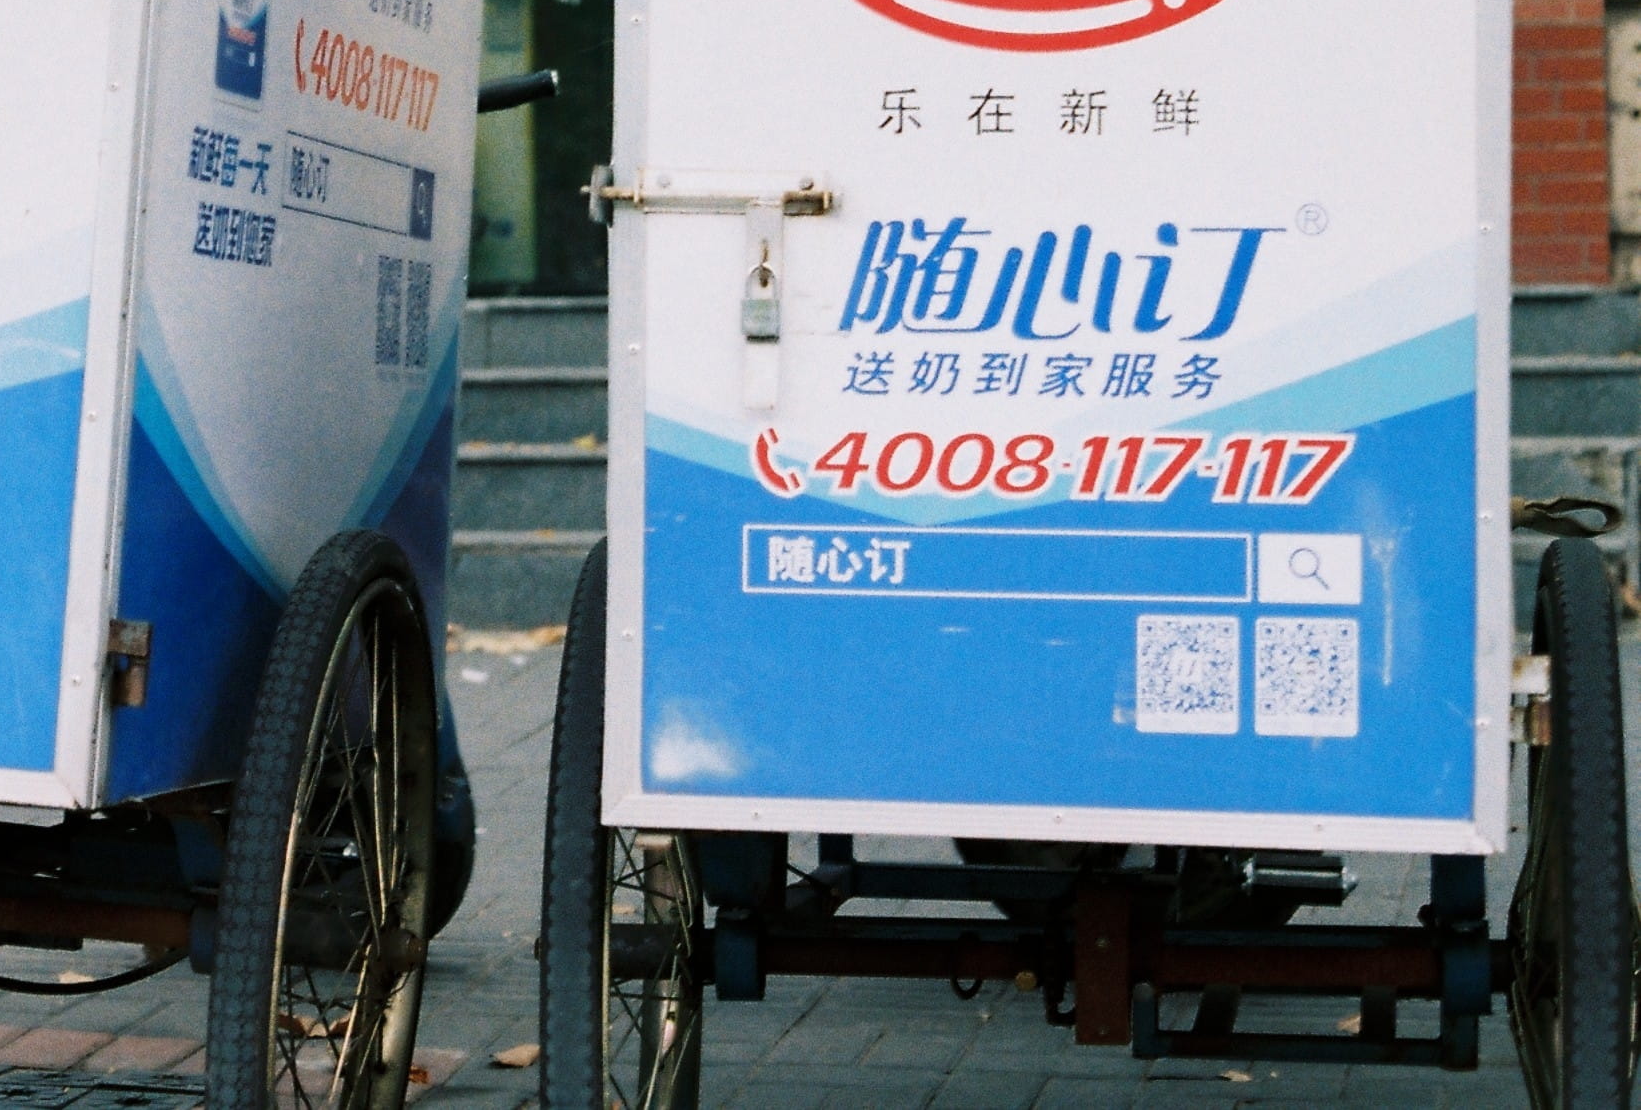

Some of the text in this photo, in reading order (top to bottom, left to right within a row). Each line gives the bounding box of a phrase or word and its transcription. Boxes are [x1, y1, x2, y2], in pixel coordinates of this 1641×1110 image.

[878, 89, 1200, 136] 乐在新鲜
[838, 217, 1287, 341] 随心订
[842, 352, 1222, 399] 送奶到家服务
[767, 536, 911, 585] 随心订
